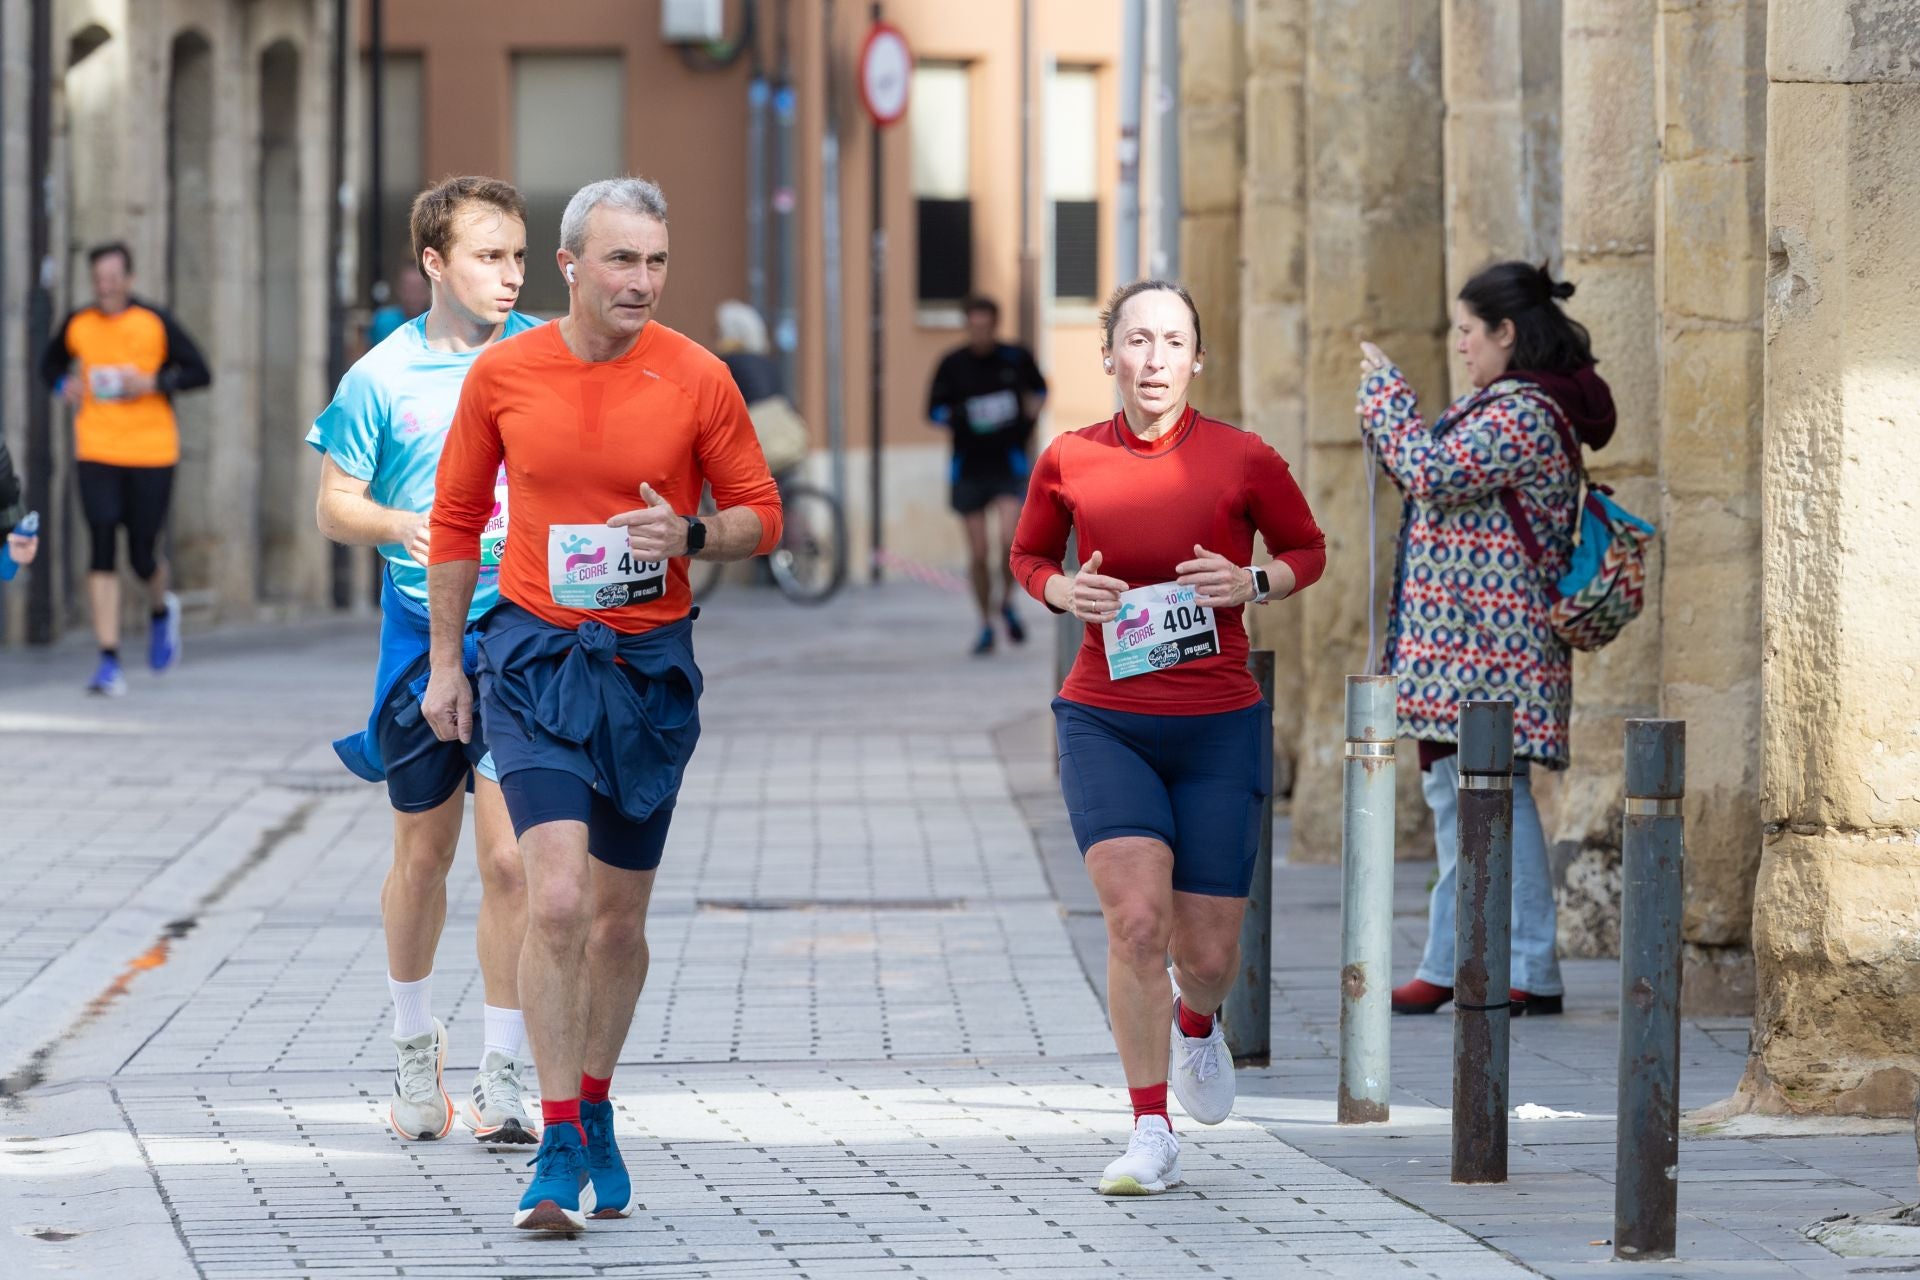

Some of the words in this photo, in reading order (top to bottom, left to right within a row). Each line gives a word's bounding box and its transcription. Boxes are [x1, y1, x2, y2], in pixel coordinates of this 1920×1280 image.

[566, 571, 578, 584] SE
[579, 562, 609, 581] CORRE
[1165, 591, 1194, 605] 10Km
[1163, 605, 1207, 633] 404
[1118, 638, 1128, 652] SE
[1129, 623, 1155, 646] CORRE
